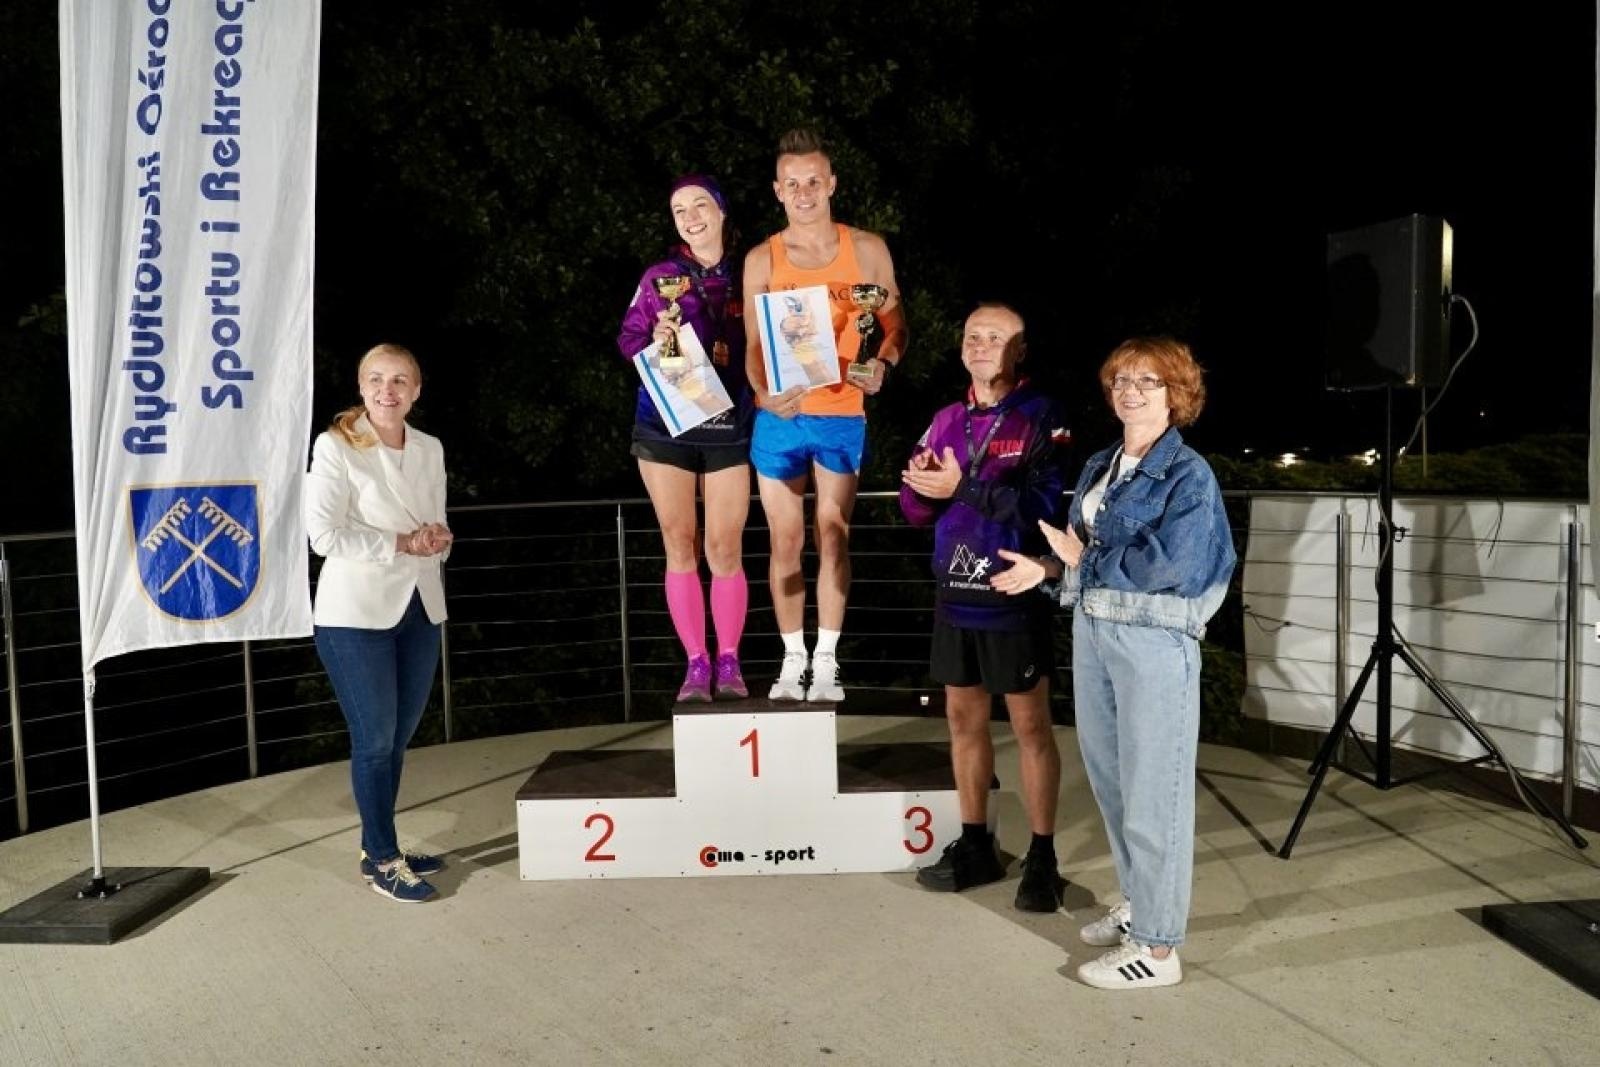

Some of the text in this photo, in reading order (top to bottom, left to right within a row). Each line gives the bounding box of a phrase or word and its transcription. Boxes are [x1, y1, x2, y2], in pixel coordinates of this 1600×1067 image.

[200, 0, 254, 409] Sportu i Rekreac
[739, 729, 760, 778] 1
[584, 813, 615, 862] 2
[904, 806, 934, 854] 3
[764, 846, 816, 866] sport
